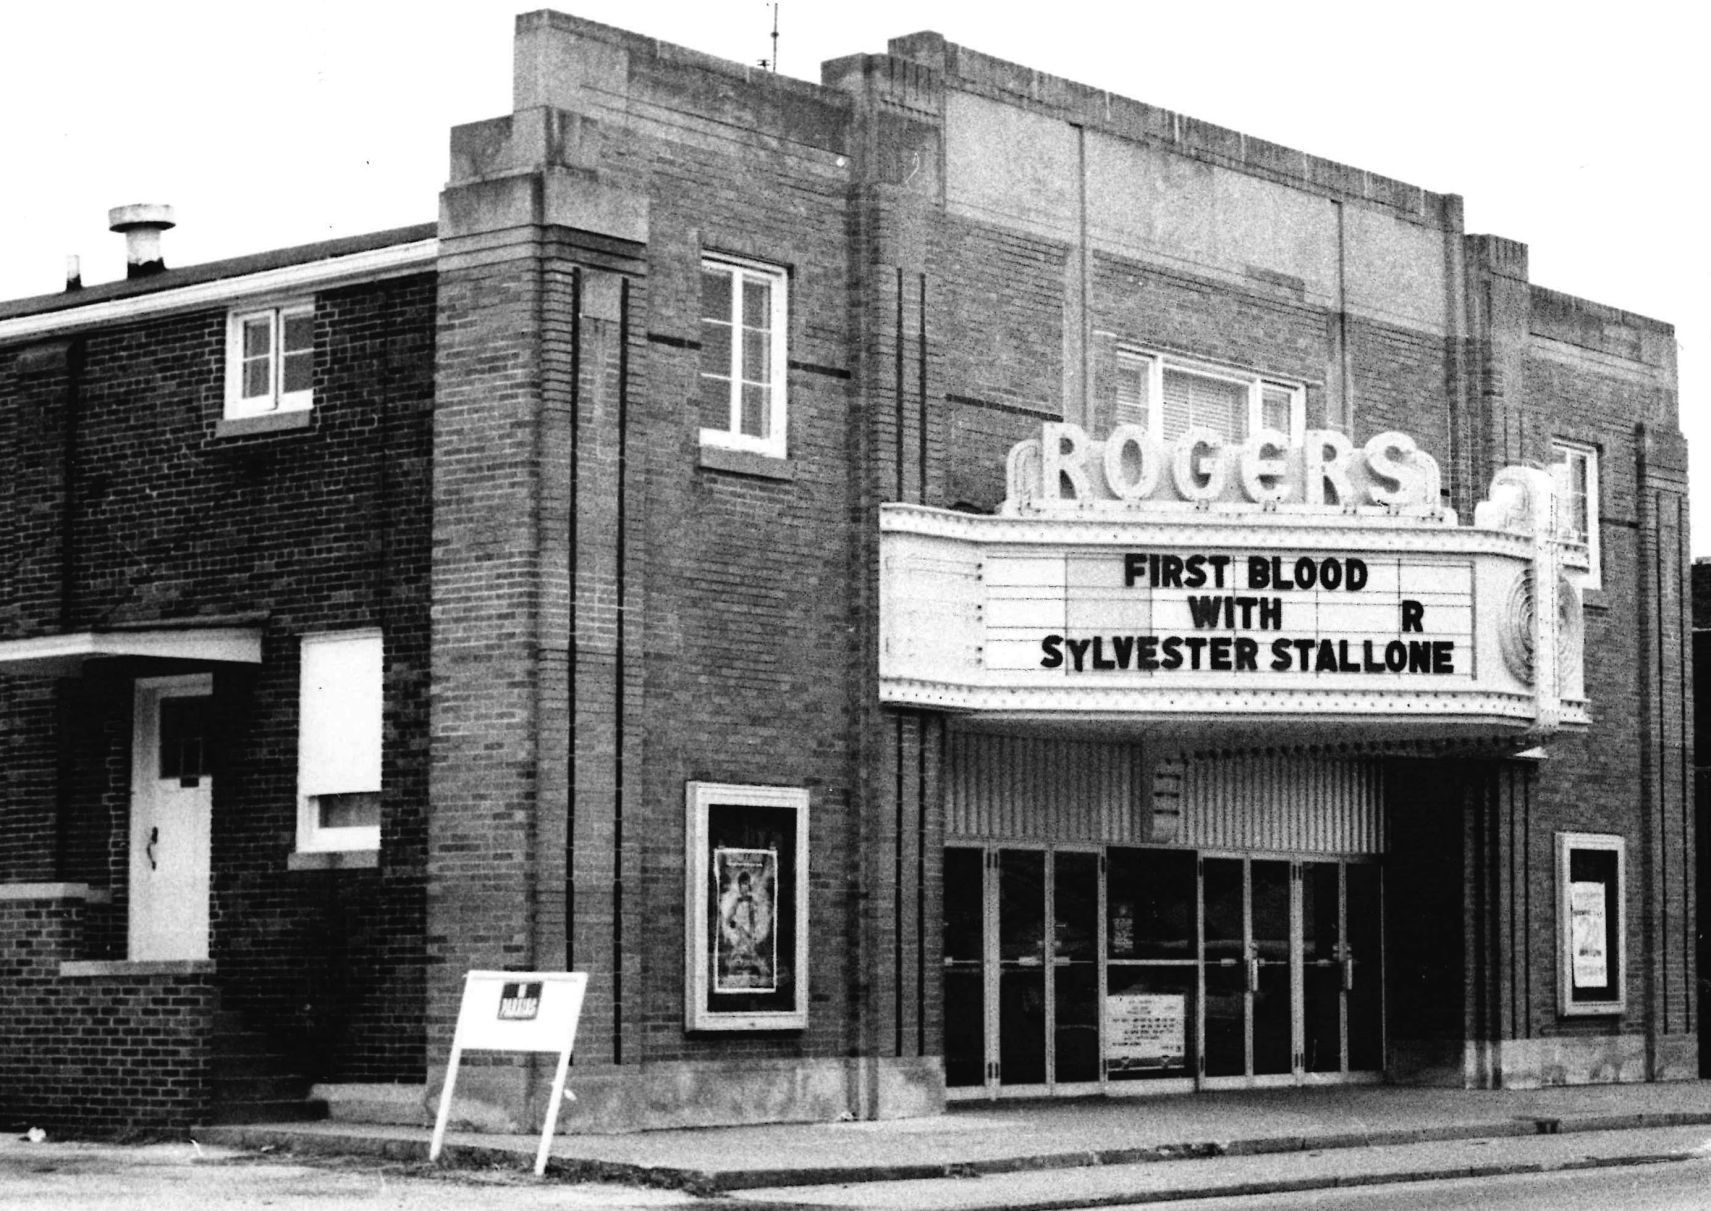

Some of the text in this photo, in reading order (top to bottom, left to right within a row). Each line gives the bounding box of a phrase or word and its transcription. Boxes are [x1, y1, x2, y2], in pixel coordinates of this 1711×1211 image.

[1043, 421, 1418, 505] ROGERS
[1125, 553, 1368, 592] FIRST BLOOD
[1187, 595, 1282, 631] WITH
[1401, 600, 1424, 633] R
[1041, 635, 1454, 674] SYLVESTER STALLONE
